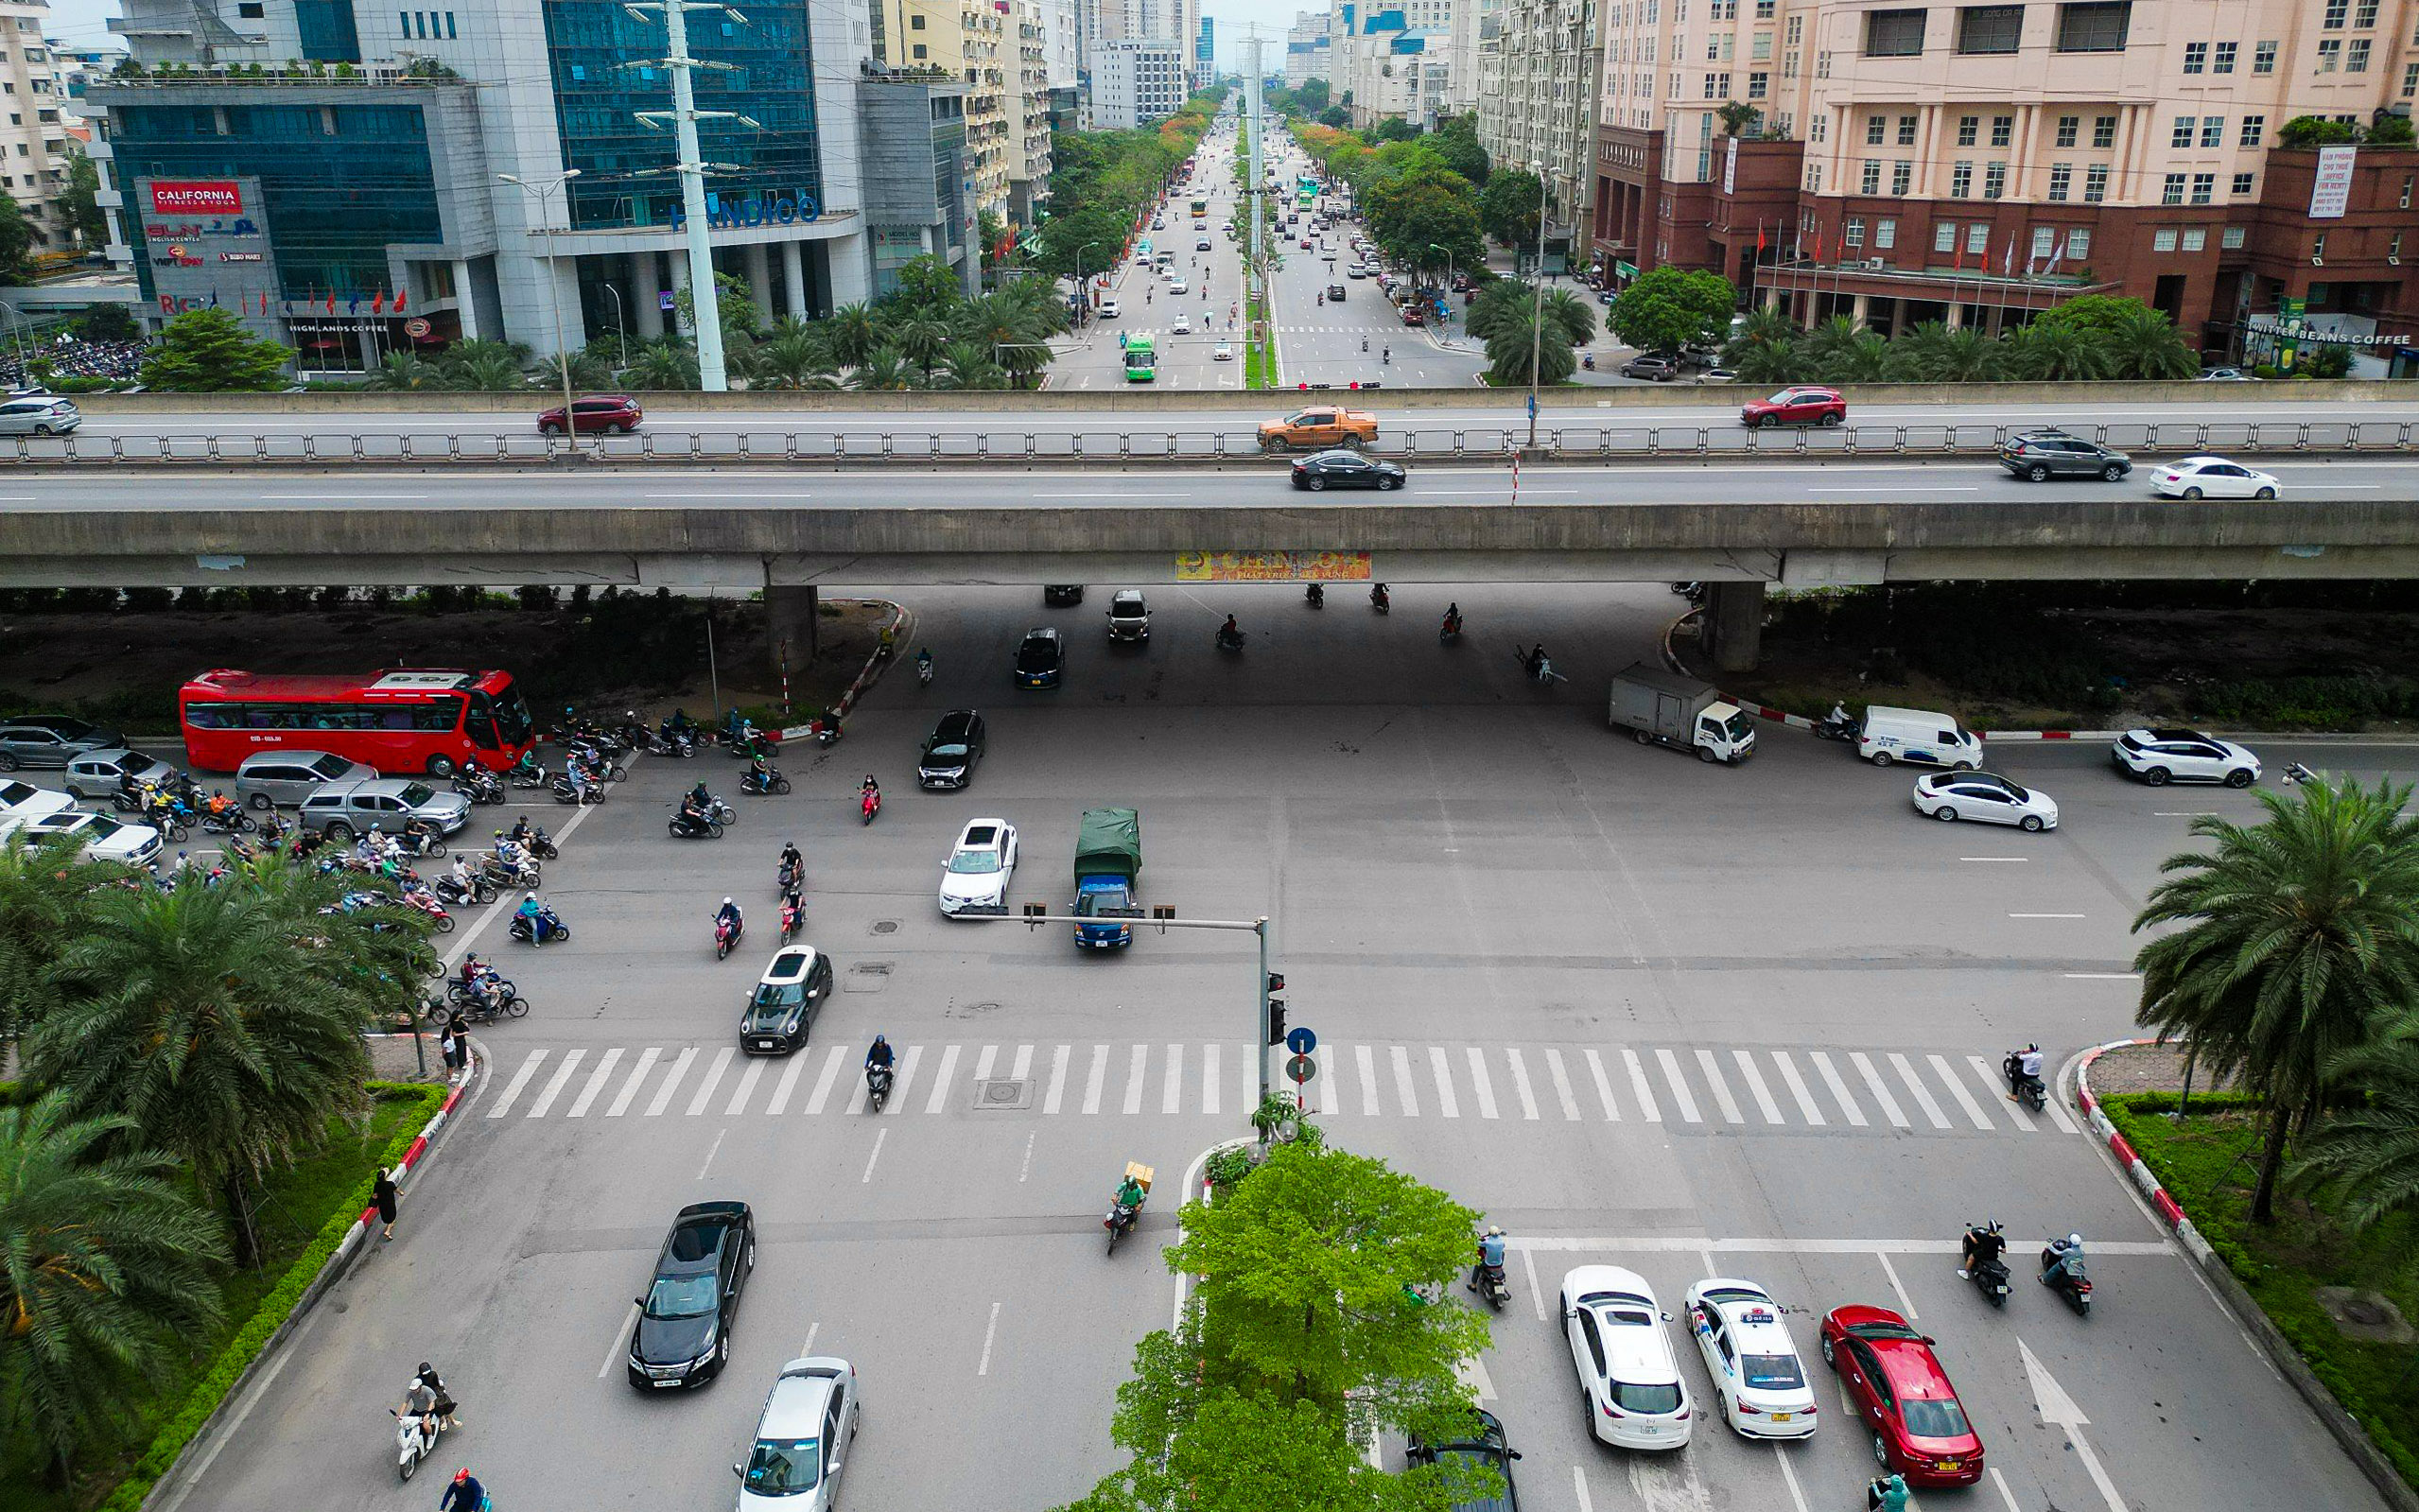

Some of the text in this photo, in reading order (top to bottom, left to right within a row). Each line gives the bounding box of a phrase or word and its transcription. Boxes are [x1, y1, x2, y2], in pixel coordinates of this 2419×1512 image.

[157, 191, 235, 200] CALIFORNIA
[2248, 322, 2411, 345] TWITTER BEANS COFFEE
